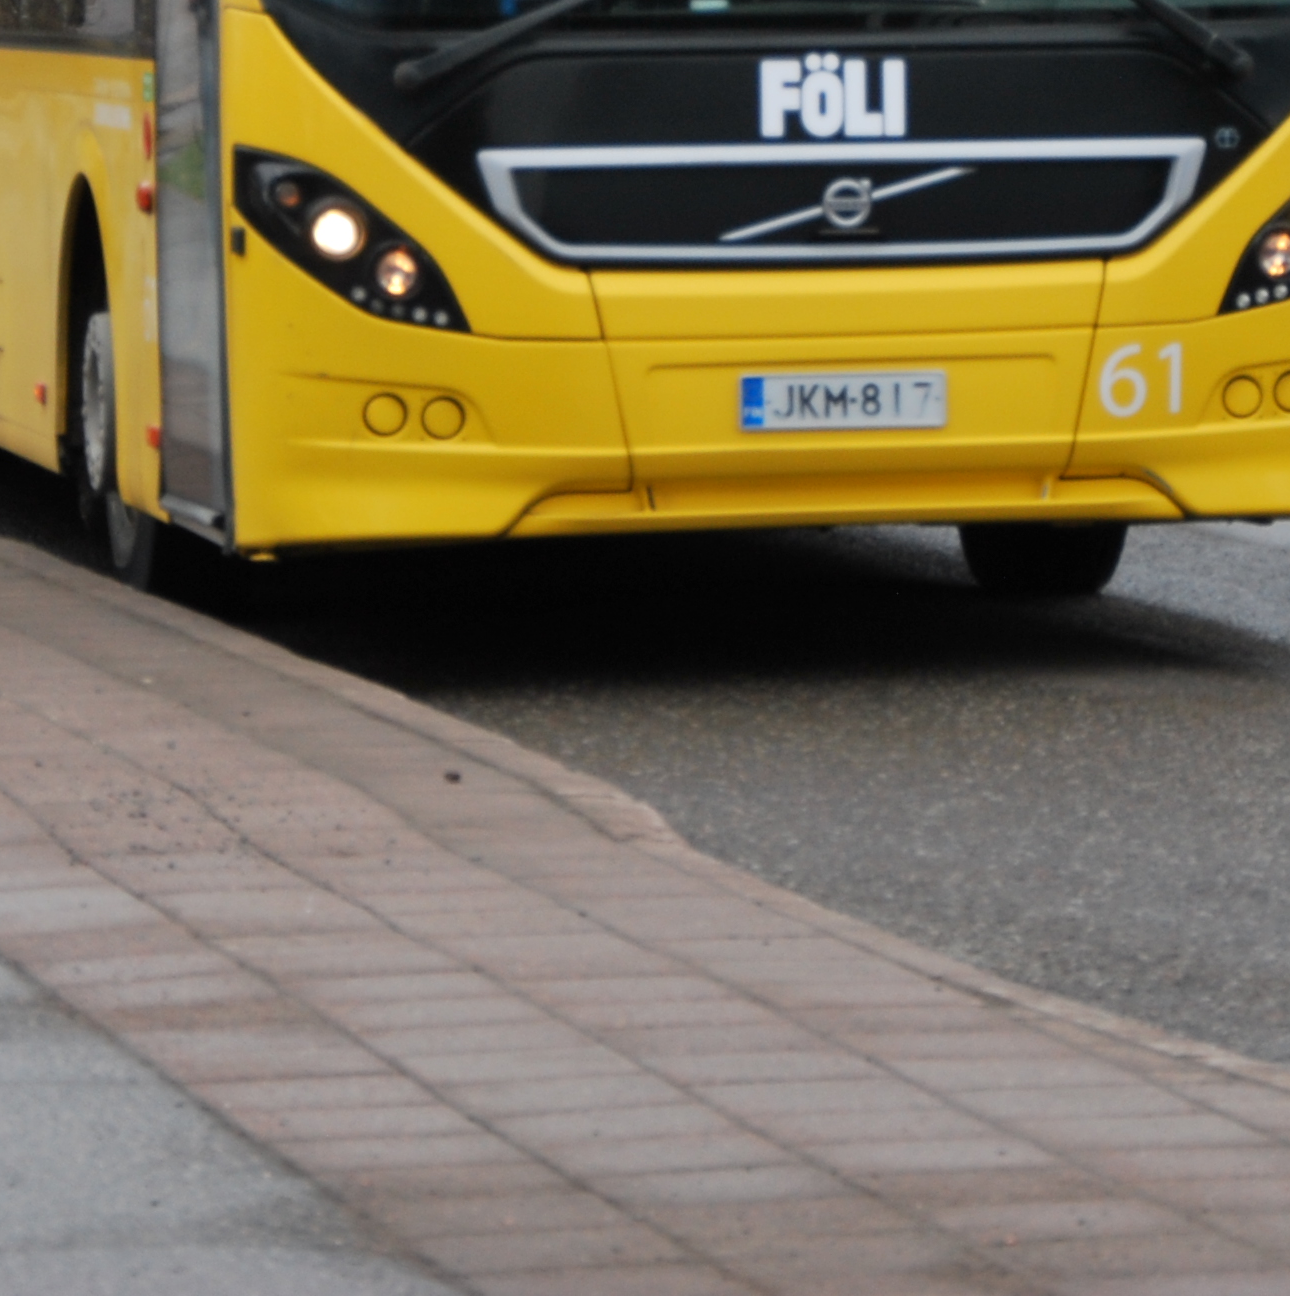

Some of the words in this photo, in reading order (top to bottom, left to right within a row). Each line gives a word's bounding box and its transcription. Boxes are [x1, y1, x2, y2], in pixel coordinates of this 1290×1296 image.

[760, 52, 906, 138] FÖLI
[773, 382, 932, 419] JKM-817
[1099, 342, 1183, 418] 61
